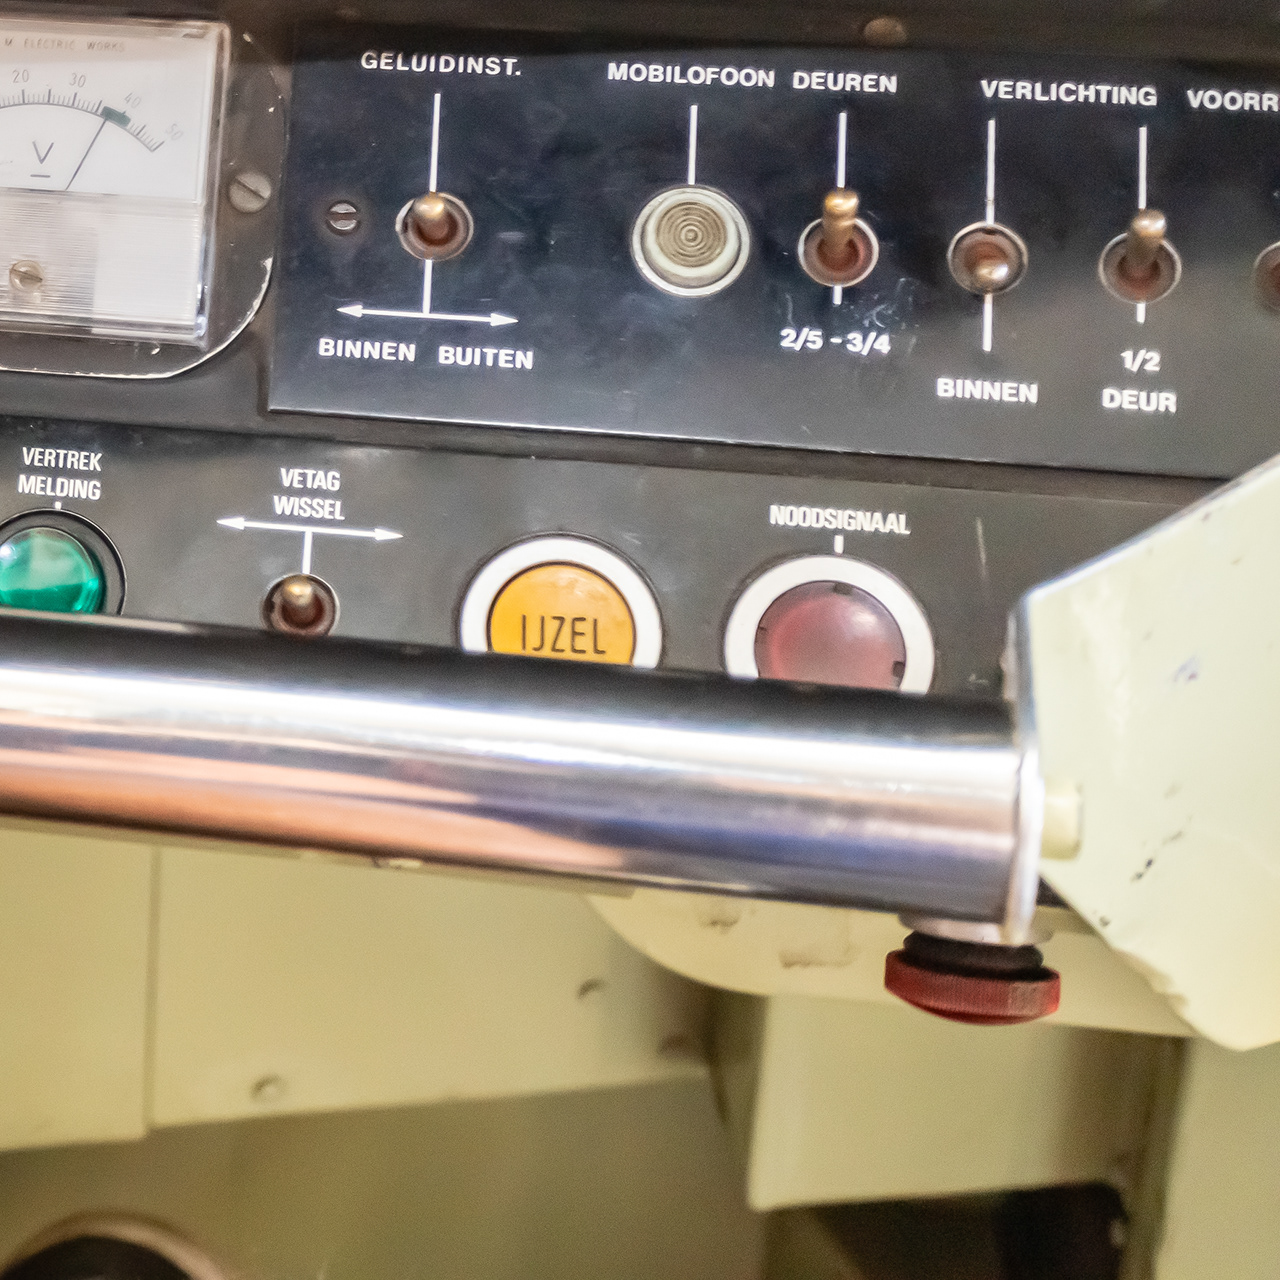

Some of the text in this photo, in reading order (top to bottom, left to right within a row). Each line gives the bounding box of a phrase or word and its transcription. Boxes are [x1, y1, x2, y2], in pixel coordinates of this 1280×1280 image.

[24, 37, 75, 51] ELECTRIC
[87, 40, 125, 52] WORKS
[11, 69, 30, 84] 20
[360, 51, 522, 78] GELUIDINST.
[607, 62, 775, 88] MOBILOFOON
[69, 73, 86, 88] 30
[792, 71, 898, 93] DEUREN
[980, 79, 1158, 107] VERLICHTING
[123, 92, 141, 109] 40
[165, 123, 184, 142] 50
[32, 141, 54, 164] V
[318, 337, 416, 362] BINNEN
[779, 327, 824, 352] 2/5
[846, 331, 892, 356] 3/4
[438, 345, 534, 370] BUITEN
[1120, 348, 1161, 373] 1/2
[936, 377, 1039, 404] BINNEN
[1101, 387, 1177, 414] DEUR
[20, 446, 103, 472] VERTREK
[17, 473, 101, 501] MELDING
[280, 467, 341, 492] VETAG
[273, 495, 346, 521] WISSEL
[769, 504, 912, 536] NOODSIGNAAL
[521, 614, 606, 654] IJZEL
